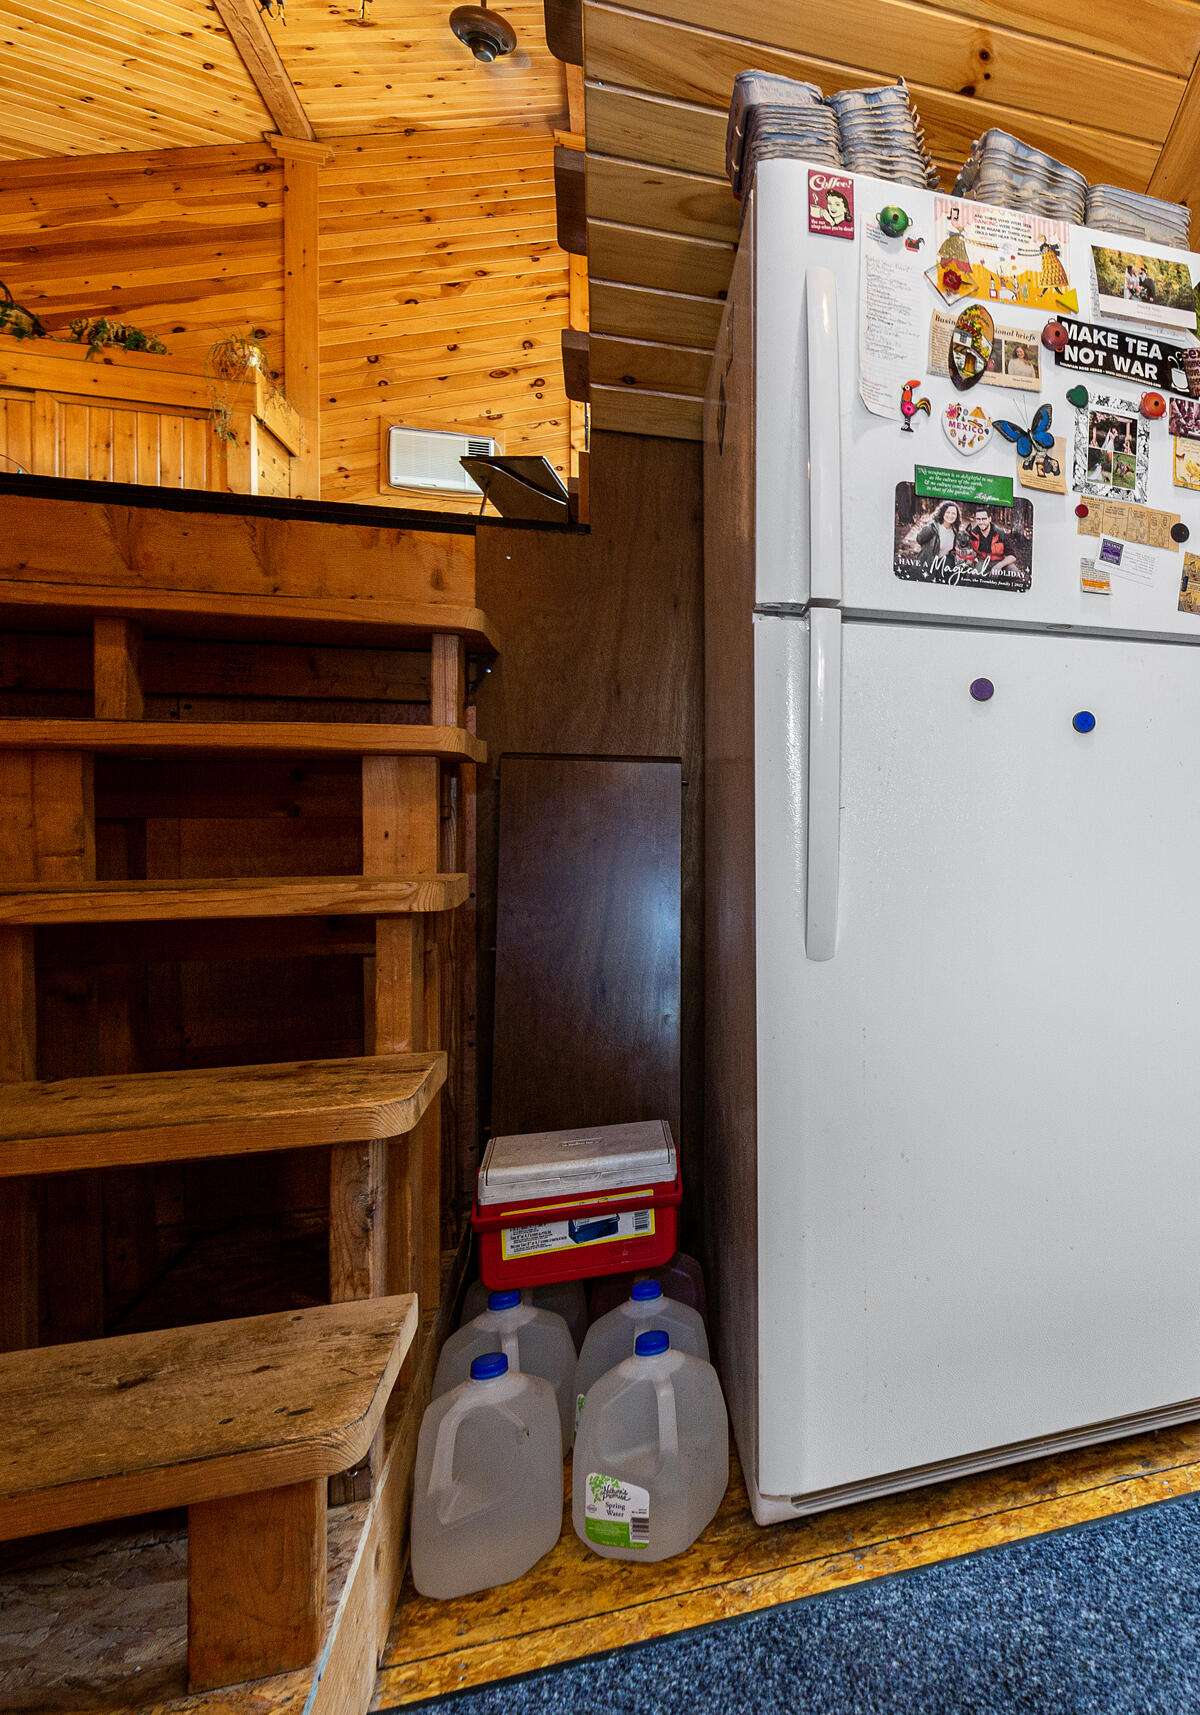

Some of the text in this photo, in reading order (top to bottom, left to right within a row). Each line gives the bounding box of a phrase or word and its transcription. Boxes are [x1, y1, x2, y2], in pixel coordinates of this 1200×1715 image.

[809, 174, 852, 191] Coffee!
[935, 315, 956, 326] Busin
[995, 328, 1014, 336] ional
[1016, 330, 1036, 341] briefs
[1062, 321, 1119, 350] MAKE
[1125, 336, 1163, 360] TEA
[1064, 345, 1158, 380] NOT WAR
[949, 421, 983, 434] MEXICO
[899, 559, 920, 567] HAVE
[930, 555, 991, 586] Magical
[992, 569, 1025, 578] HOLIDAY
[606, 1502, 626, 1511] Spring
